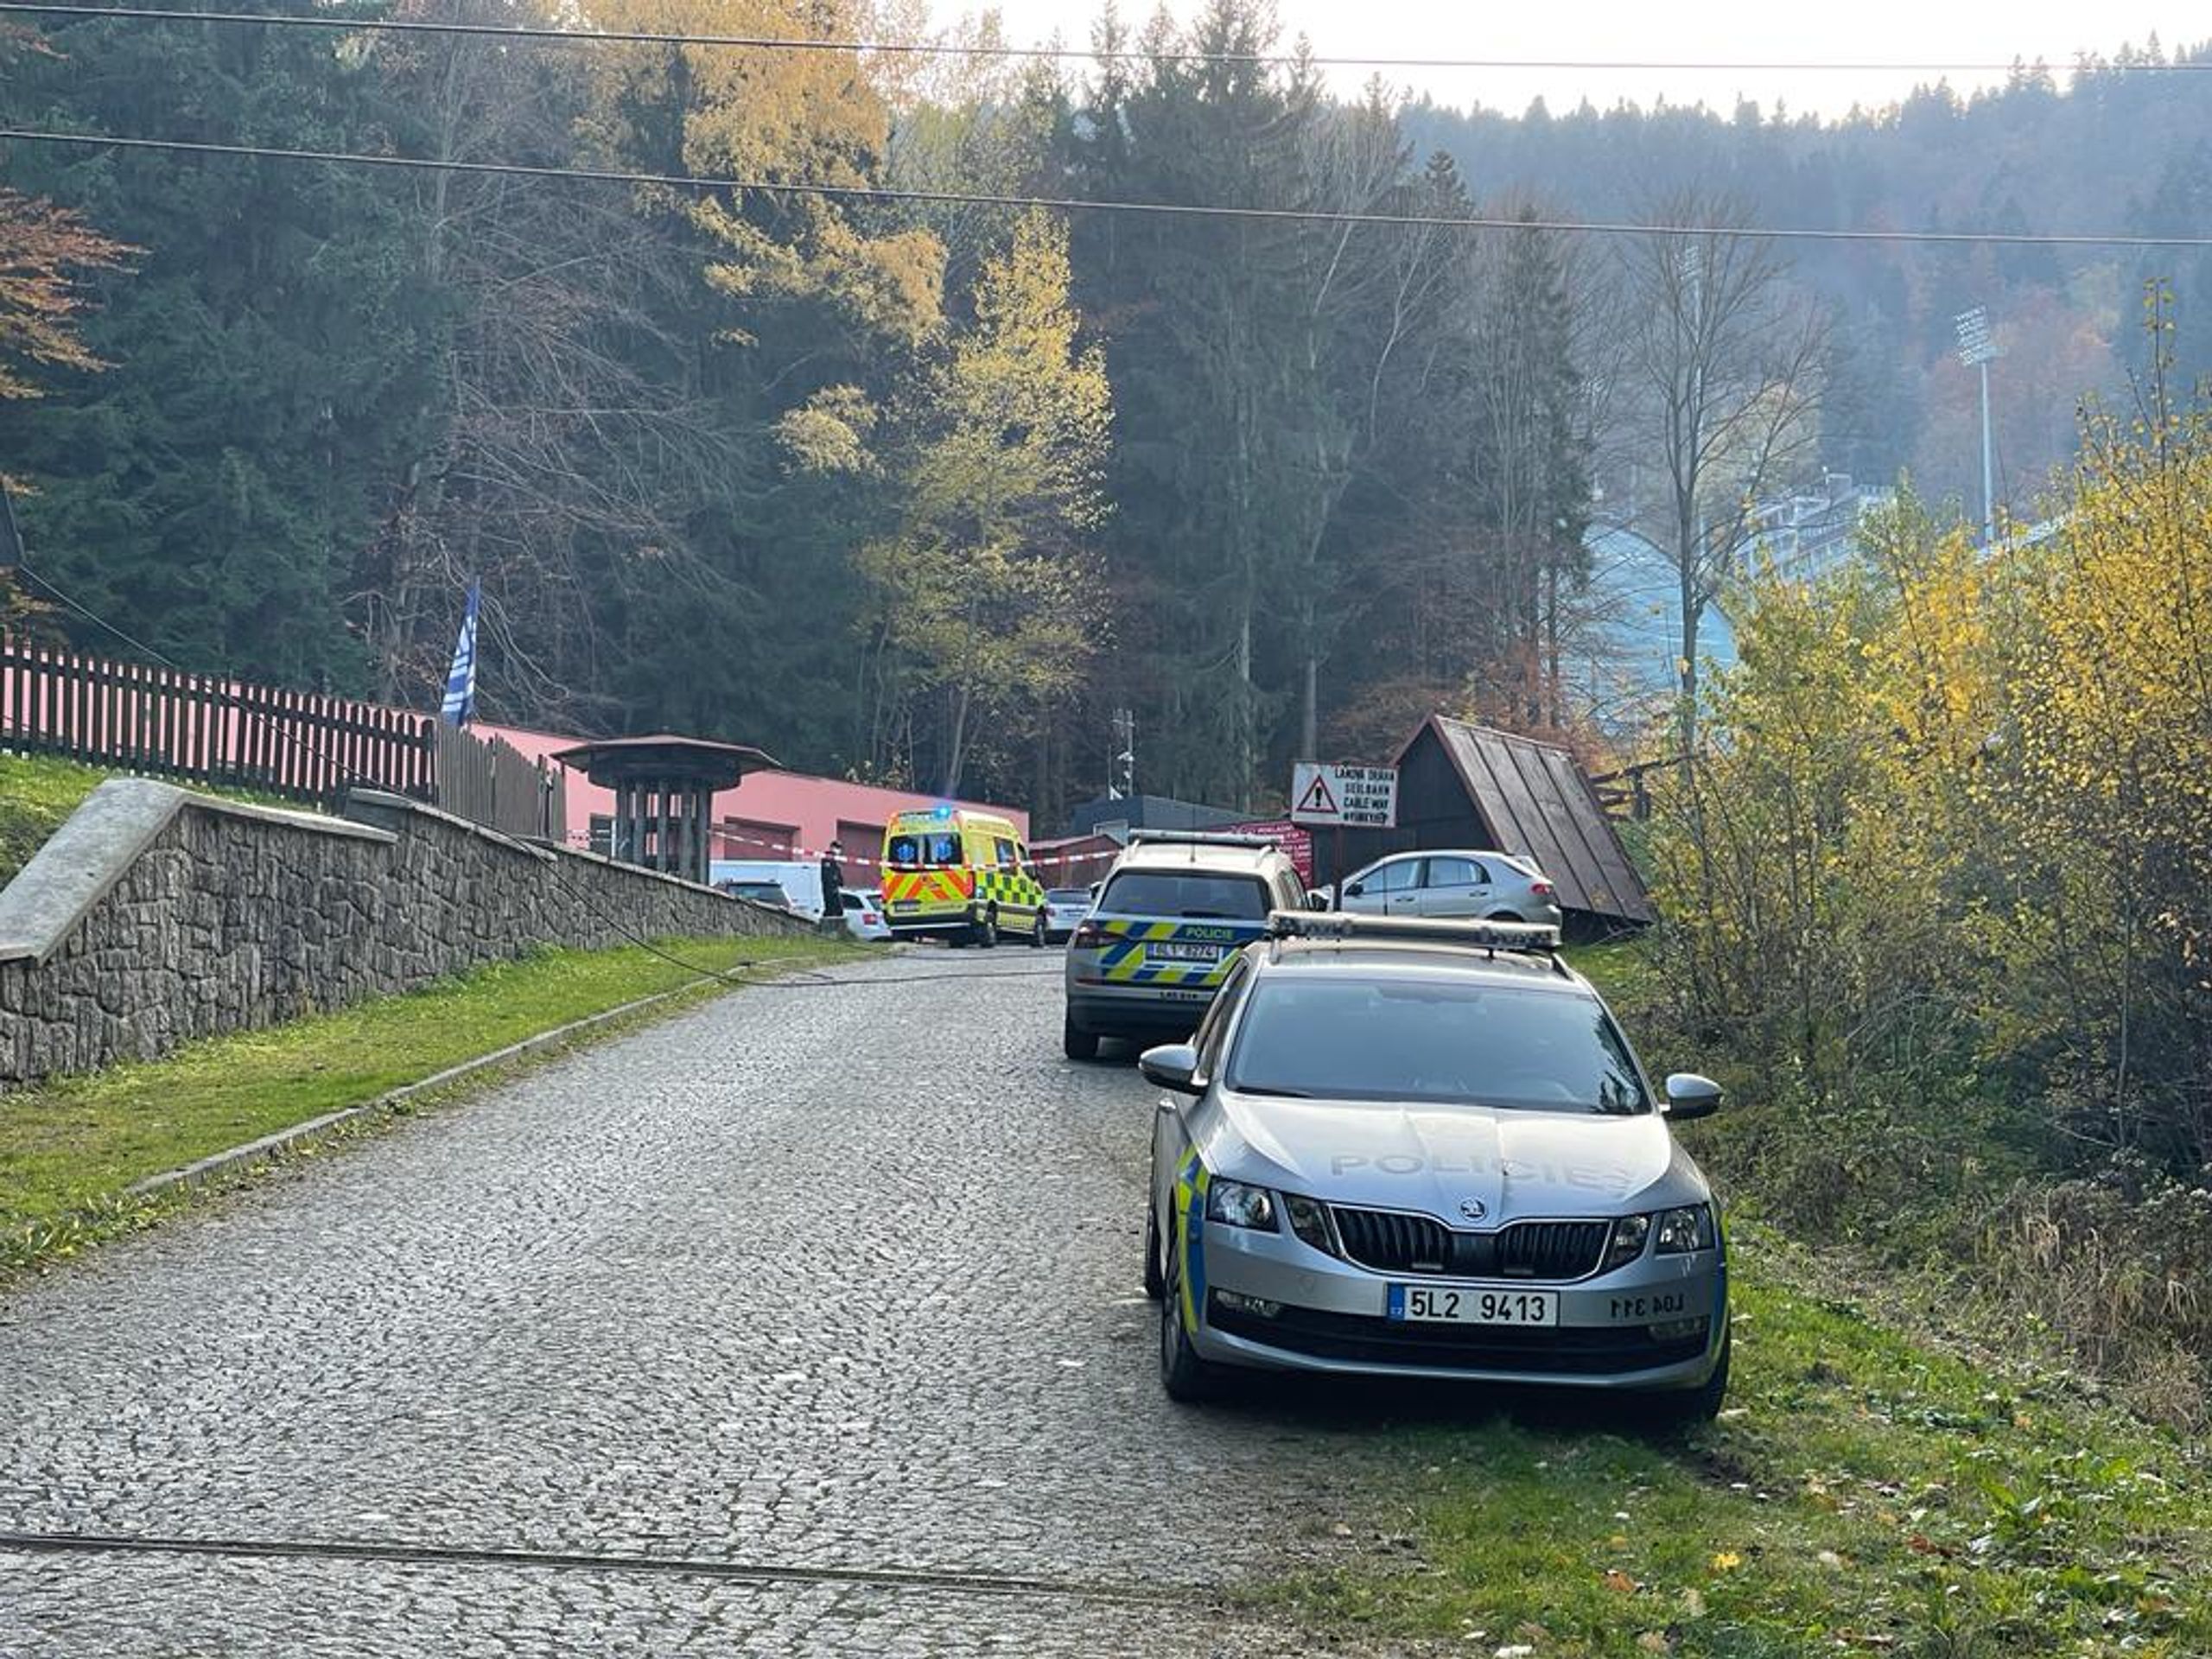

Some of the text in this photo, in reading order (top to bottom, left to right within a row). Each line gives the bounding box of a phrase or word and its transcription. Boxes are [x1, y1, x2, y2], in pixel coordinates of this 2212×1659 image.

[1185, 926, 1234, 940] POLICIE
[1410, 1290, 1459, 1319] 5L2
[1480, 1294, 1546, 1322] 9413
